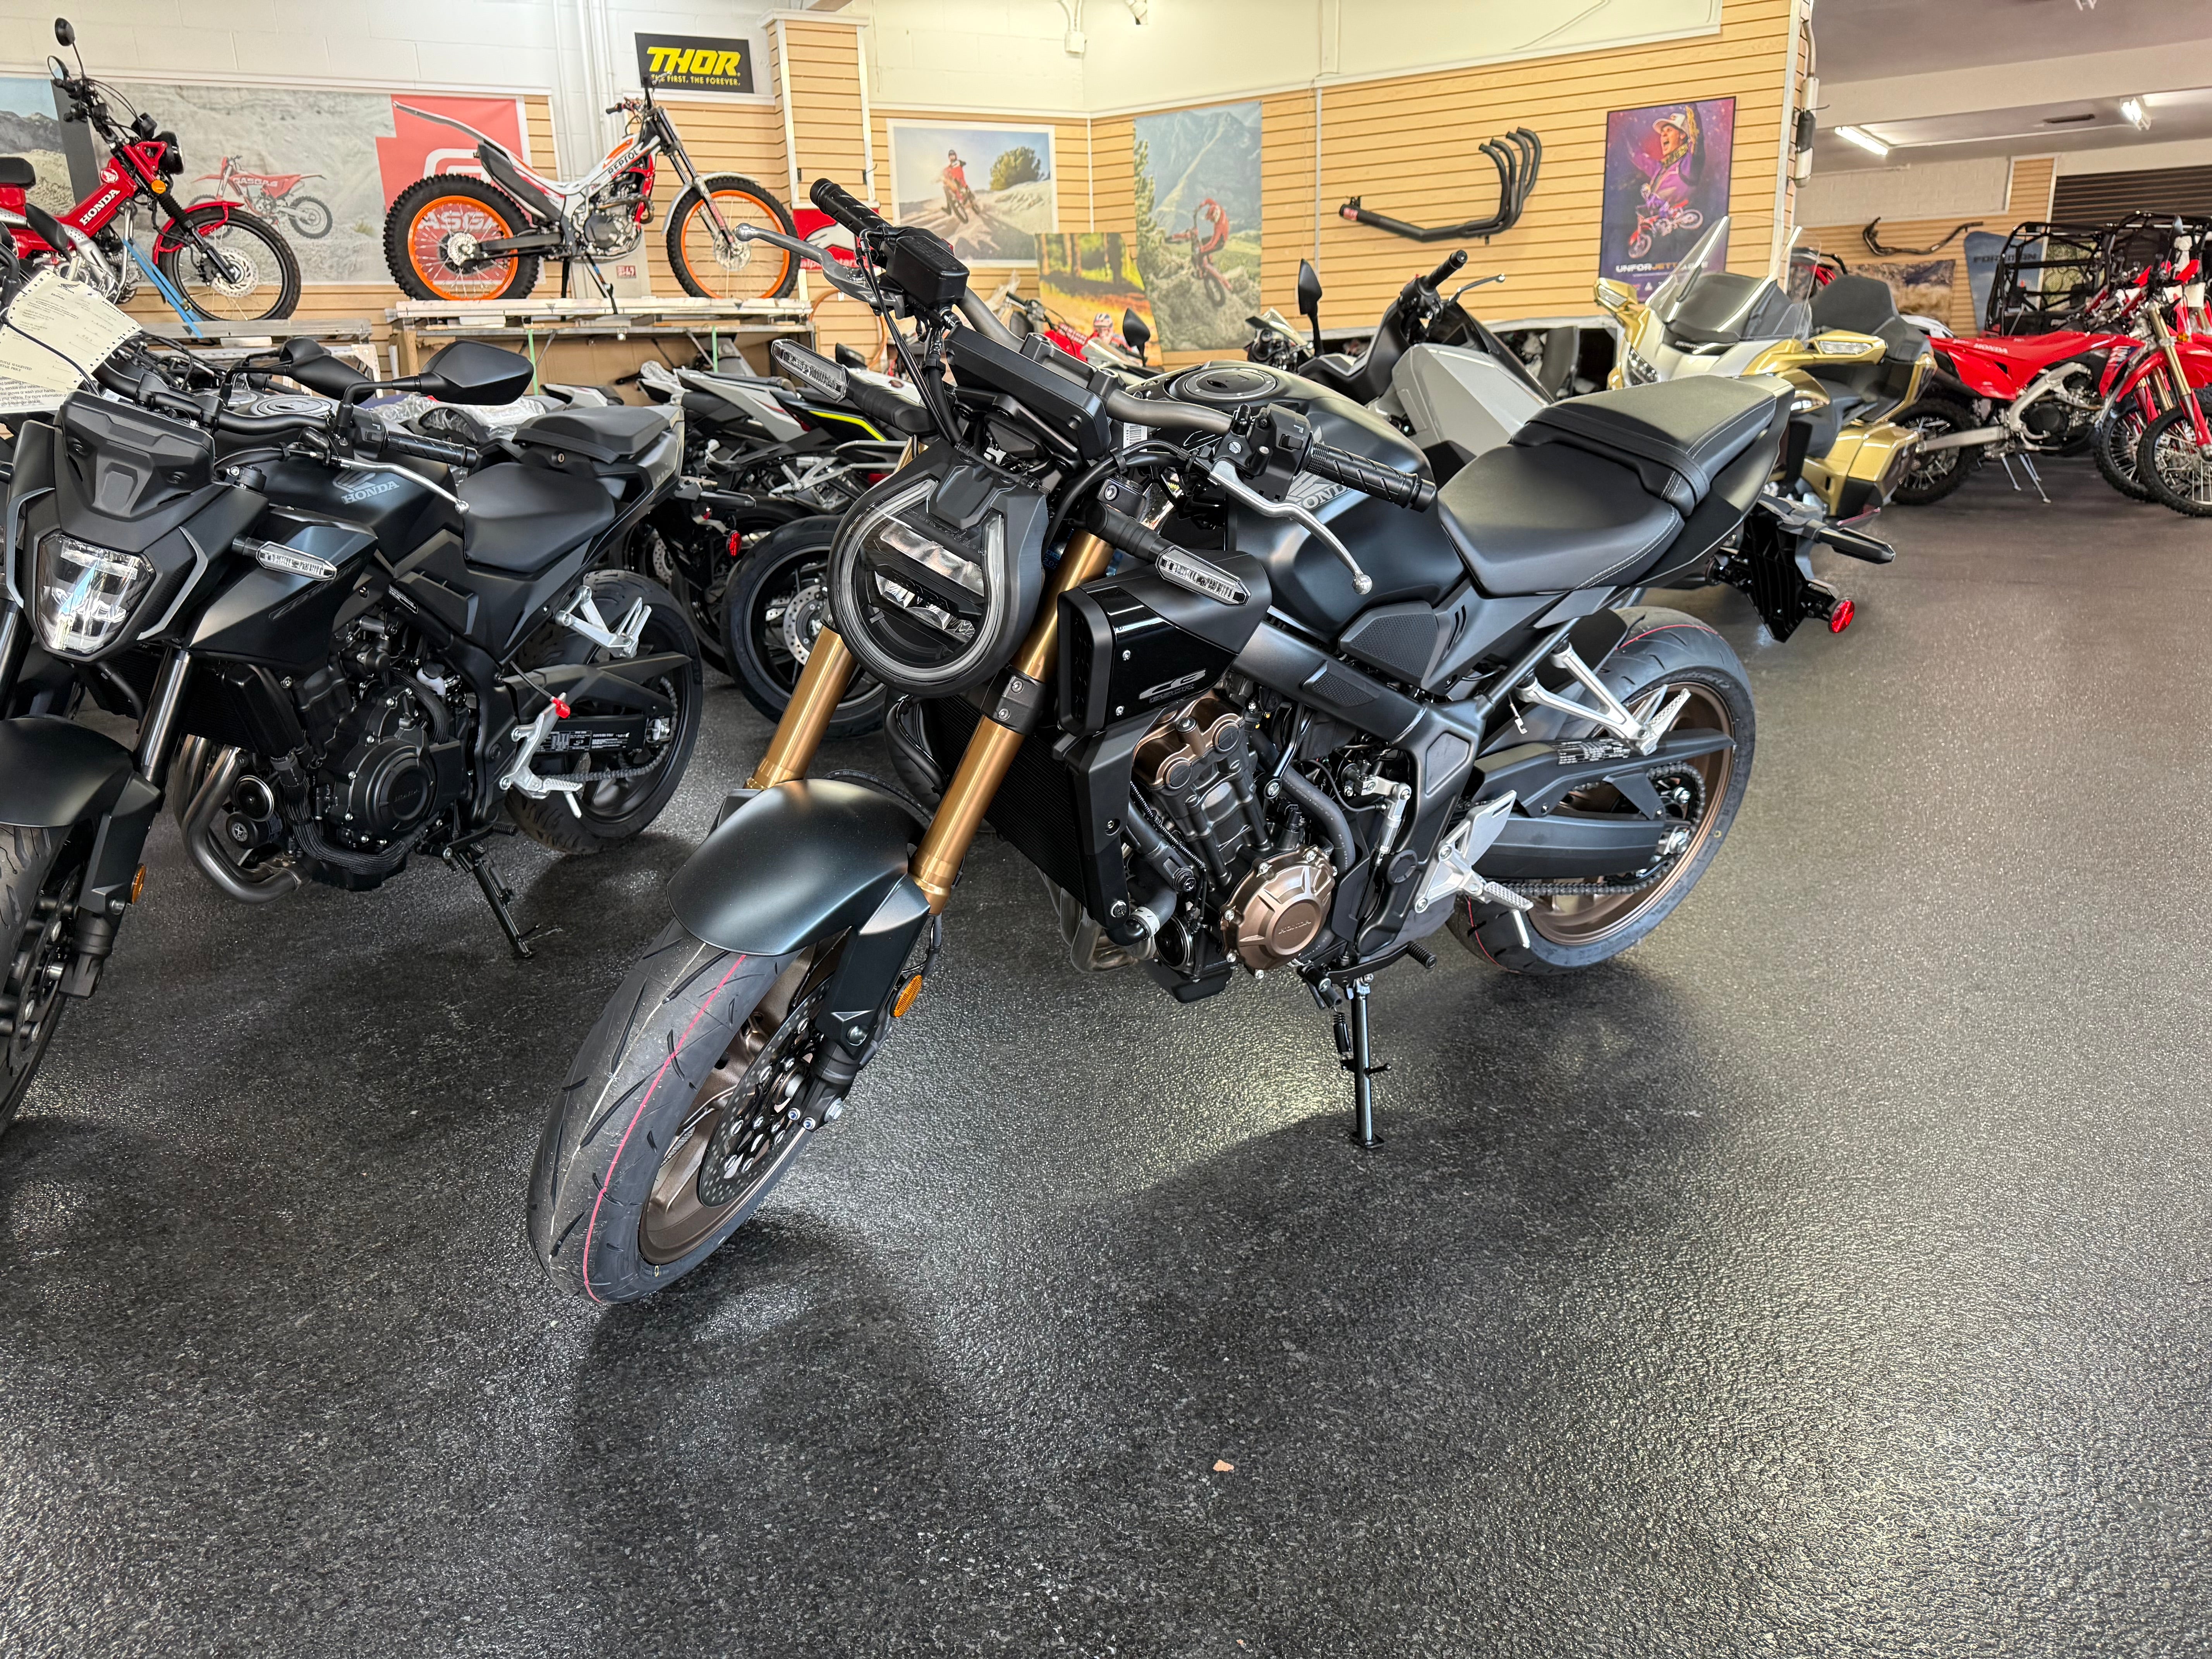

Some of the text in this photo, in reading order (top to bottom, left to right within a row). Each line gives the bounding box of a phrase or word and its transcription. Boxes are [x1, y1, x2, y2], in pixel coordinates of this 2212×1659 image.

[647, 46, 740, 76] THOR
[667, 75, 689, 83] FIRST.
[706, 77, 740, 86] FOREVER.
[608, 150, 639, 176] REPSOL
[79, 189, 120, 226] HONDA
[1973, 343, 2008, 354] HONDA
[341, 481, 400, 505] HONDA
[1297, 484, 1352, 509] OND
[1278, 921, 1312, 934] HONDA
